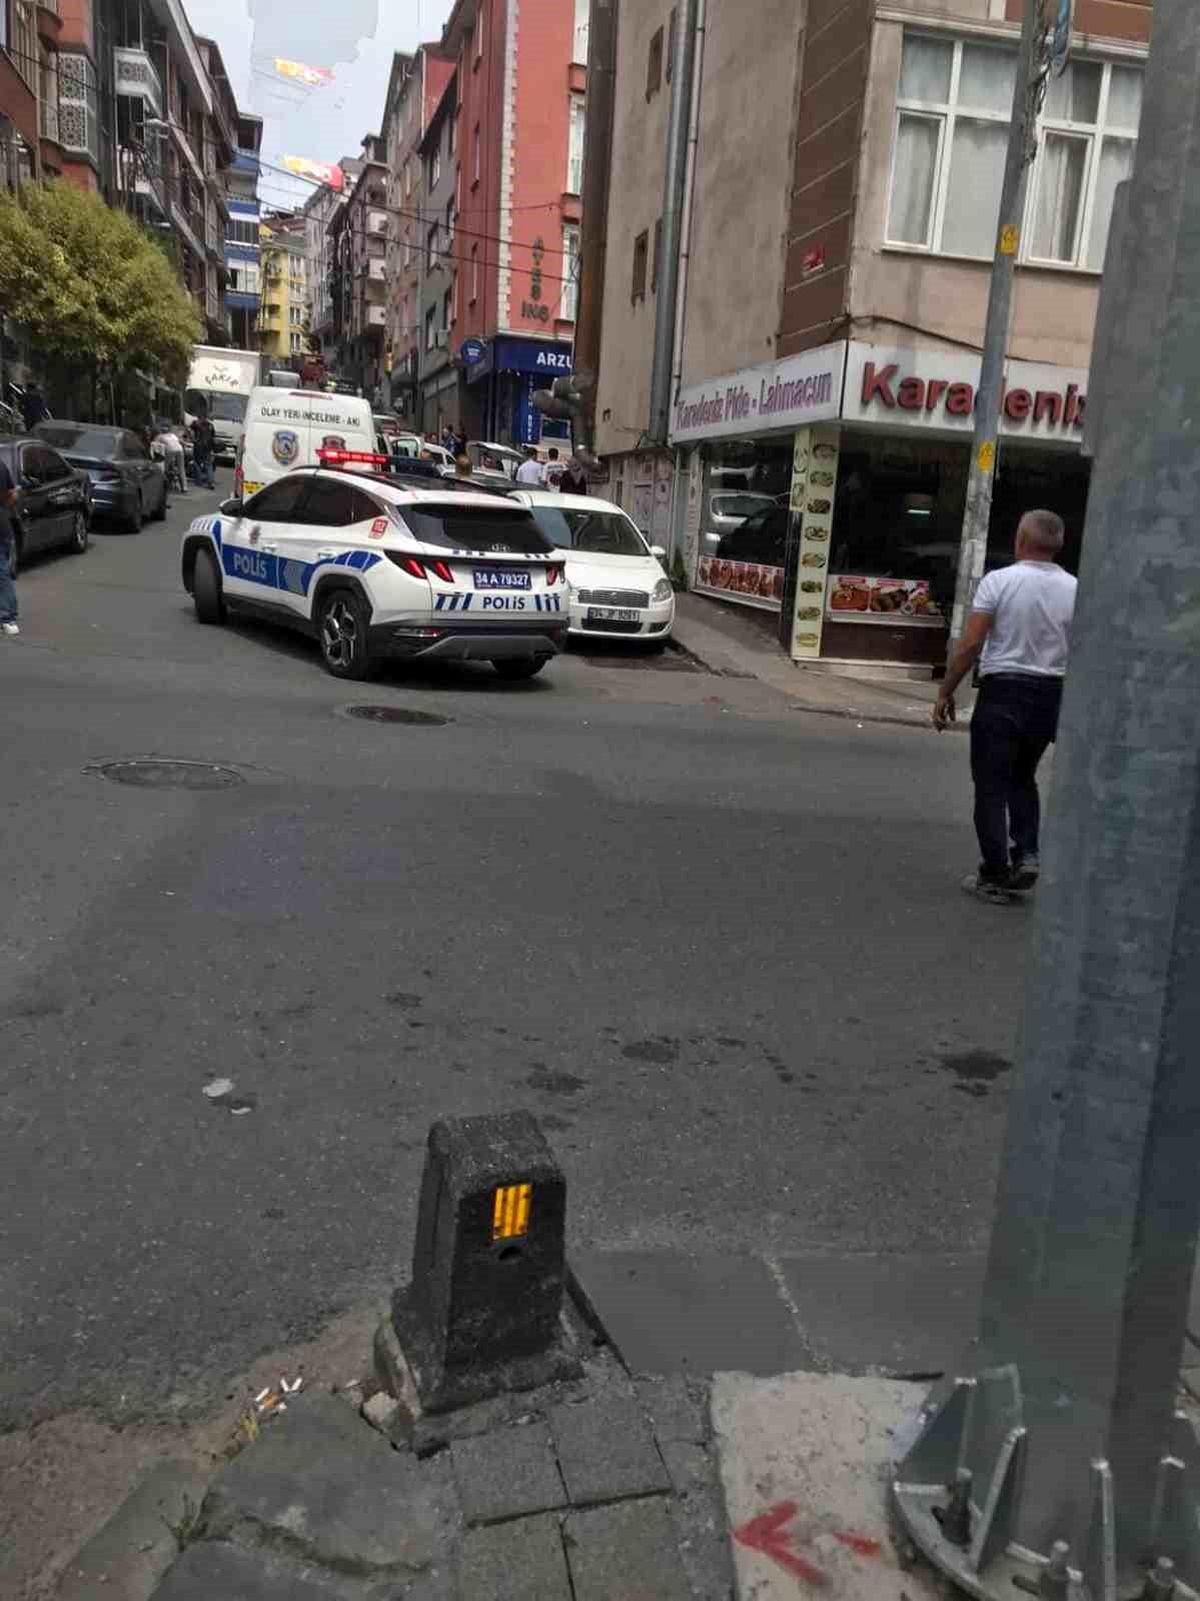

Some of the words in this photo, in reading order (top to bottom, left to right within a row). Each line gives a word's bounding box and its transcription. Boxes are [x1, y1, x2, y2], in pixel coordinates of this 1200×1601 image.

[676, 391, 725, 431] Karadeniz
[725, 383, 751, 422] Pide
[759, 371, 833, 415] Lahmacun
[860, 361, 1086, 426] Karaeni
[260, 407, 281, 417] OLAY
[490, 573, 498, 584] A
[482, 594, 526, 611] POLİS
